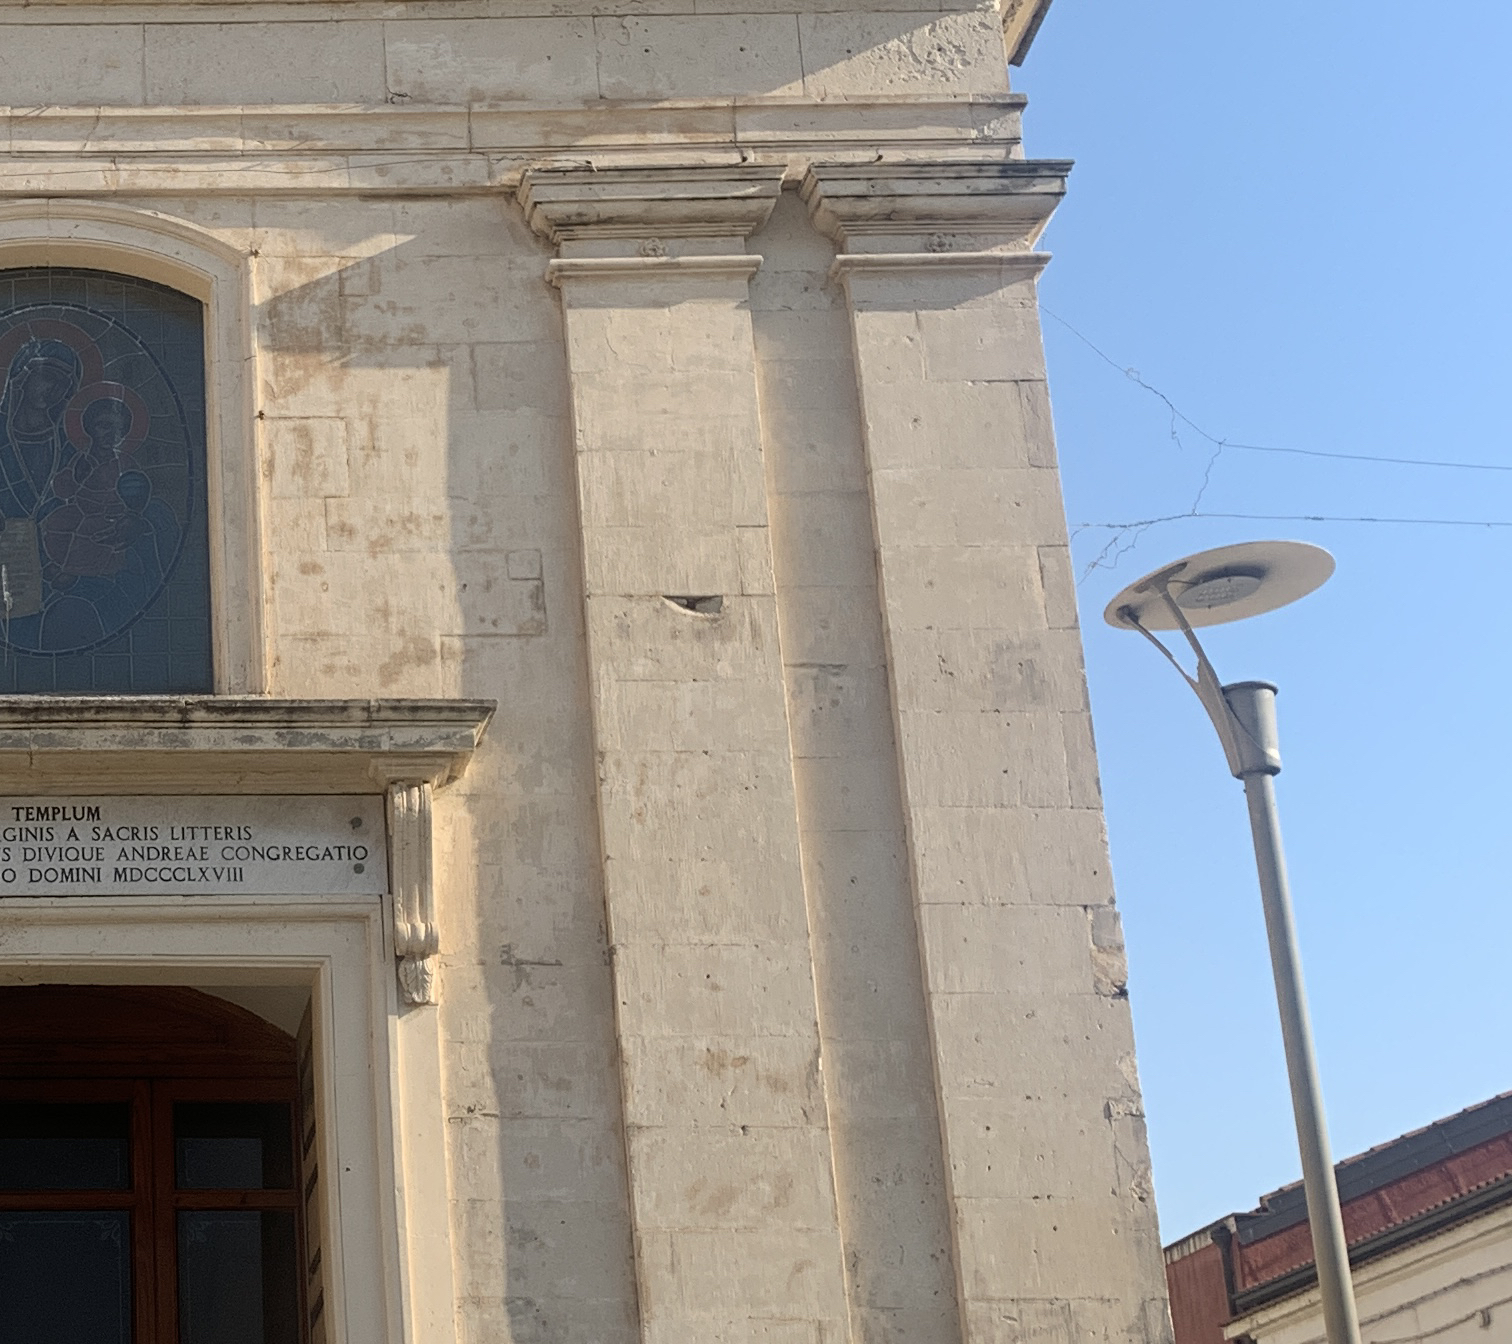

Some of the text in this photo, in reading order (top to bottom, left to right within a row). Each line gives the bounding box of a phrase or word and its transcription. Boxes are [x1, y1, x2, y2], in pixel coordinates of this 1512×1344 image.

[11, 806, 102, 823] TEMPLUM
[66, 826, 80, 842] A
[91, 826, 159, 842] SACRIS
[170, 825, 253, 841] LITTERIS
[22, 846, 105, 863] DIVIQUE
[116, 846, 210, 862] ANDREAE
[221, 845, 369, 861] CONGREGATIO
[28, 867, 102, 884] DOMINI
[113, 866, 244, 883] MDCCCLXVIII
